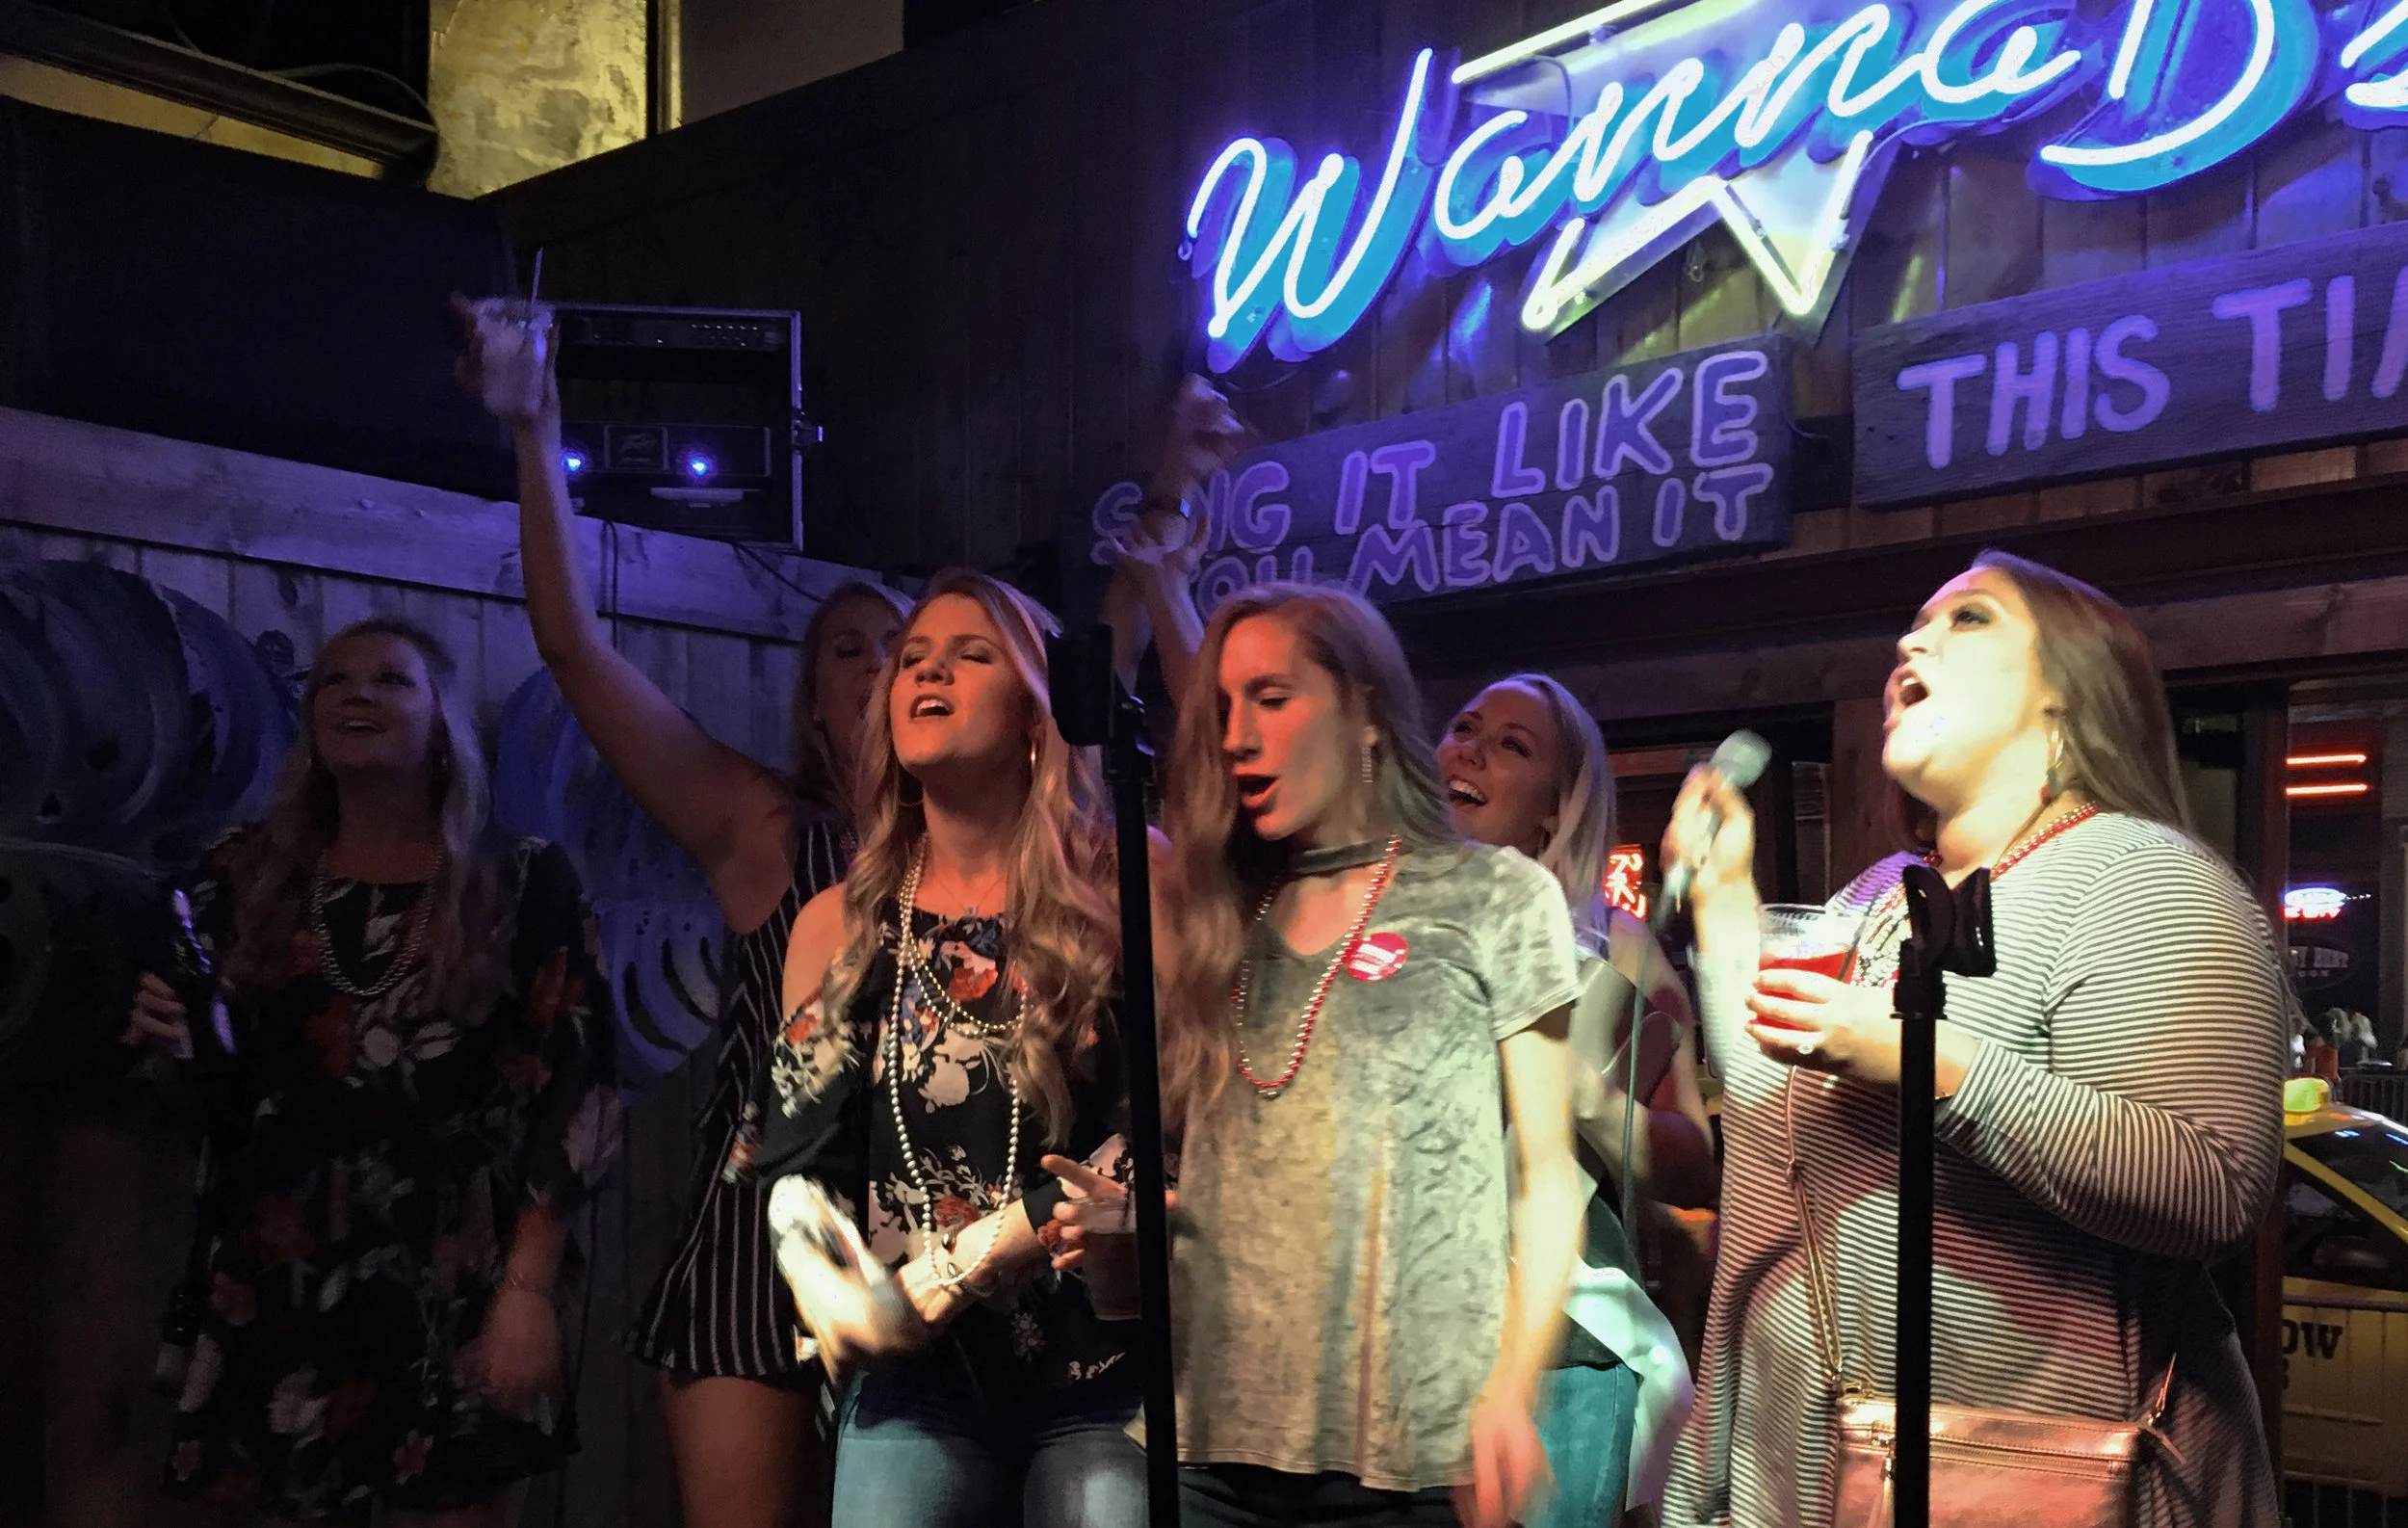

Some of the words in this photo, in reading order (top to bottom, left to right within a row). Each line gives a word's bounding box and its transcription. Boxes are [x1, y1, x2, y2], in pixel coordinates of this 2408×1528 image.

[1334, 439, 1437, 536] IT
[1491, 350, 1768, 498] LIKE
[1896, 313, 2171, 470] THIS
[1348, 484, 1621, 597] MEAN
[1652, 462, 1774, 548] IT
